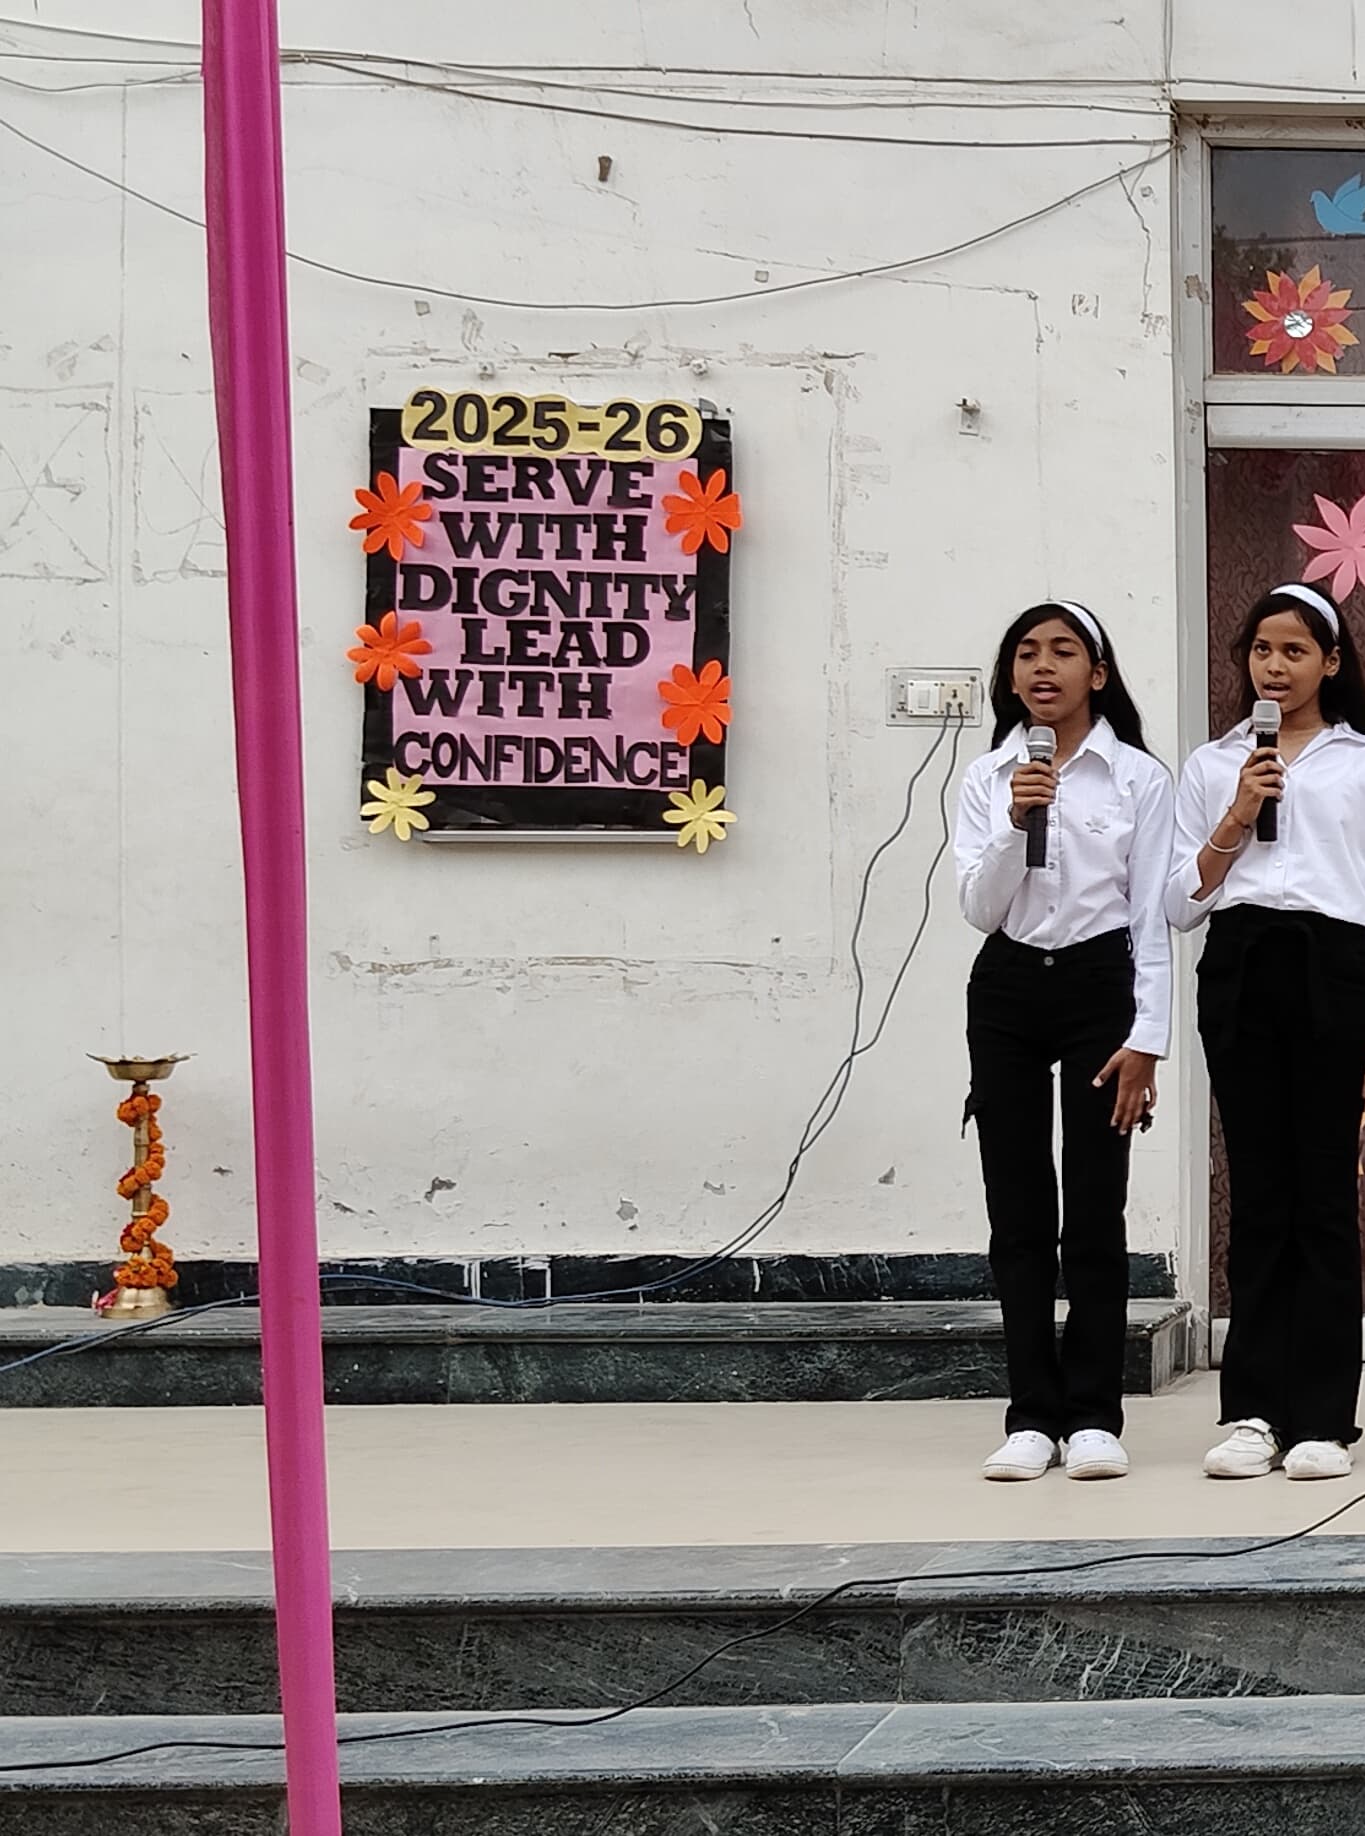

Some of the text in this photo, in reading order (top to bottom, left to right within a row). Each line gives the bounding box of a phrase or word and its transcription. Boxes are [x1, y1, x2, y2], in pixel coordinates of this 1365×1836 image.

[411, 391, 690, 453] 2025-26
[422, 452, 655, 509] SERVE
[439, 511, 648, 562] WITH
[400, 563, 697, 621] DIGNITY
[460, 618, 651, 668] LEAD
[398, 669, 613, 720] WITH
[394, 731, 689, 789] CONFIDENCE
